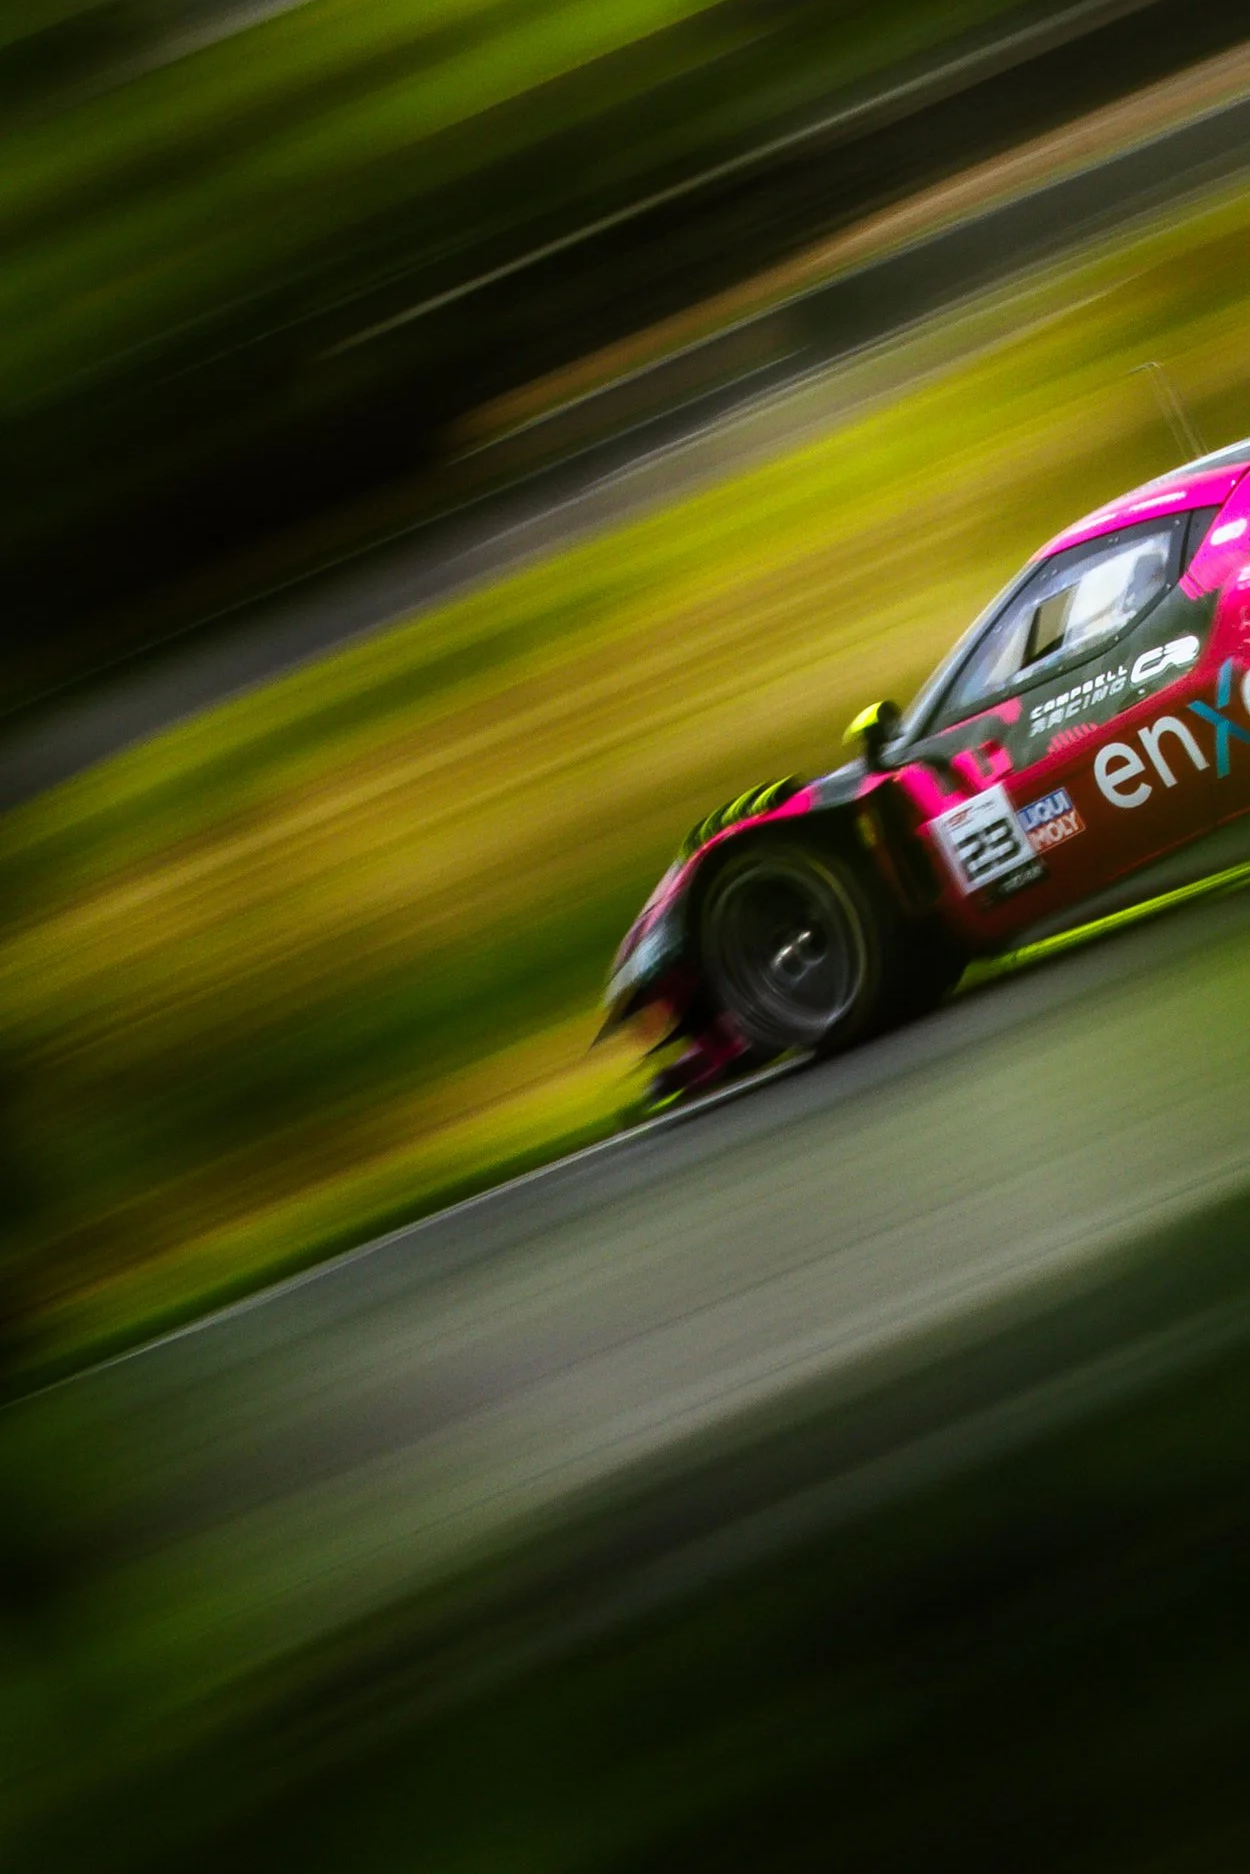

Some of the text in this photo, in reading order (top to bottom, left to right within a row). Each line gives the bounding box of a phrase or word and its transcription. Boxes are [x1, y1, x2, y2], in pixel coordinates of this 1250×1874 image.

[1029, 665, 1129, 720] CAMPBELL
[1029, 677, 1128, 738] RACING
[1017, 790, 1071, 833] LIQUI
[1028, 810, 1080, 853] MOLY
[956, 817, 1021, 883] 23
